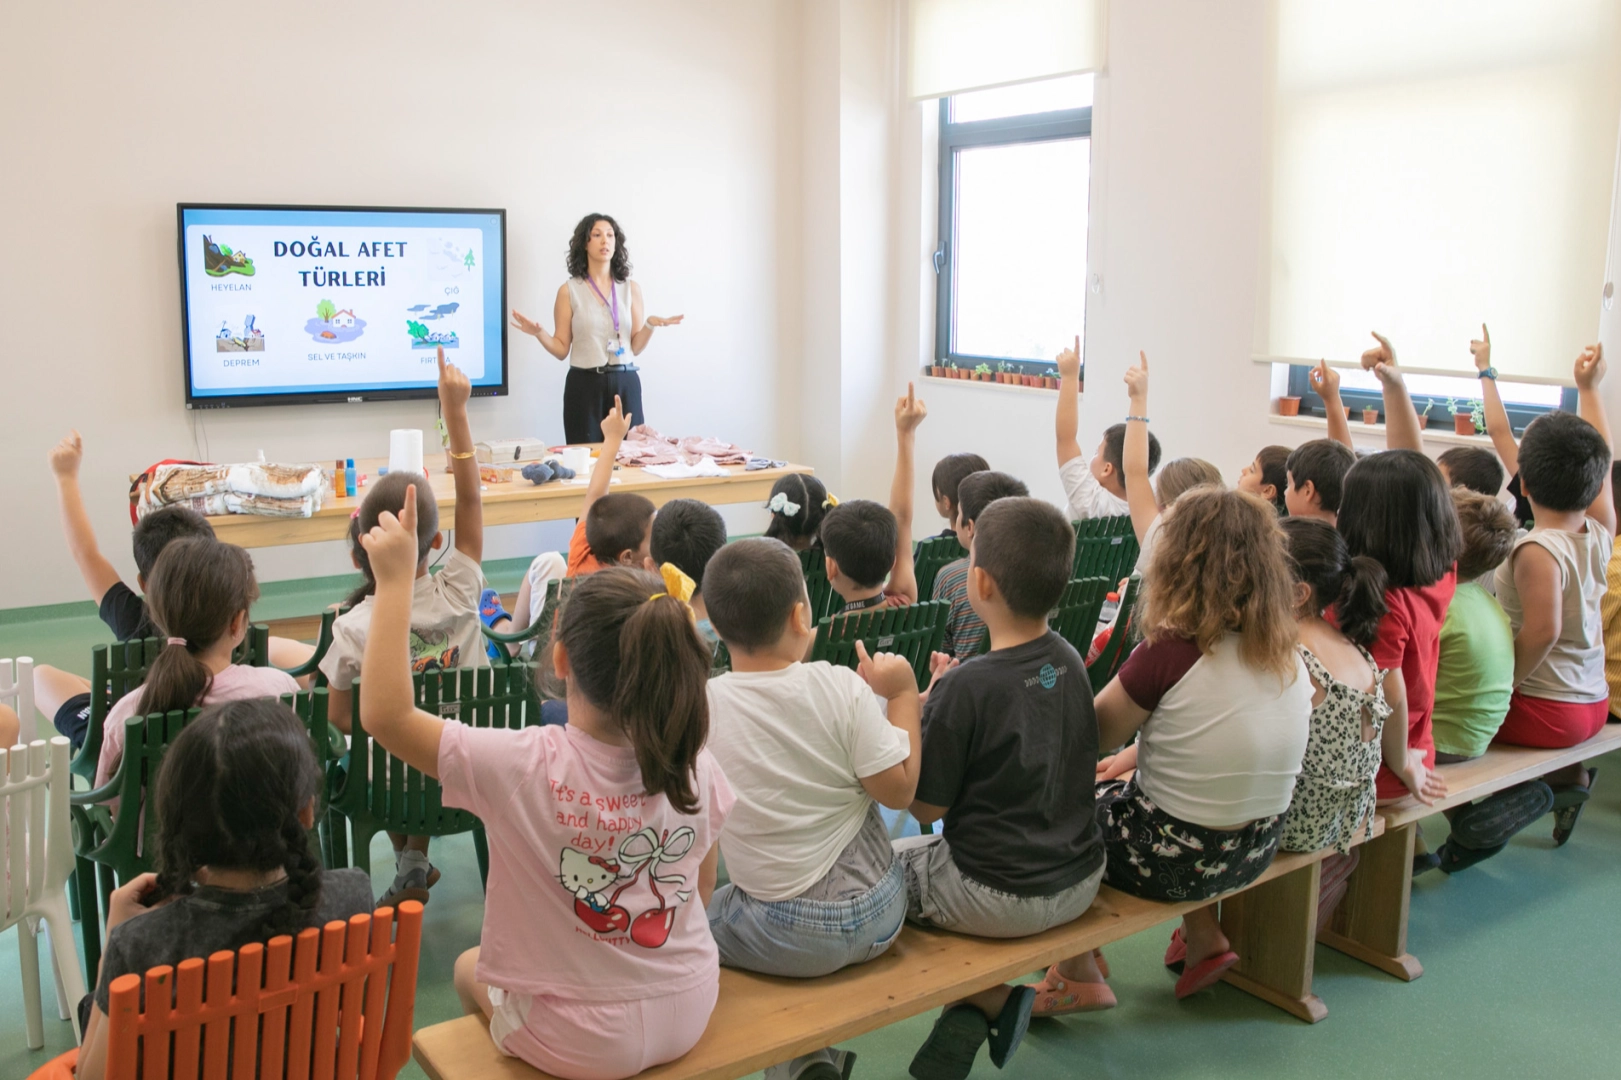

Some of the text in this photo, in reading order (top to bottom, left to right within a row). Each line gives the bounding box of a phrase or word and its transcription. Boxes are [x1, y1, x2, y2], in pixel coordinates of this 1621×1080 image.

[274, 236, 408, 258] DOĞAL AFET
[298, 266, 386, 287] TÜRLERİ
[211, 283, 252, 292] HEYELAN
[444, 286, 460, 296] ÇIĞ
[223, 359, 260, 367] DEPREM
[308, 352, 366, 362] SEL VE TAŞKIN
[420, 356, 451, 364] FIRTA
[580, 791, 592, 807] a
[595, 790, 646, 812] sweet
[556, 810, 642, 835] and happy
[570, 832, 615, 853] day!
